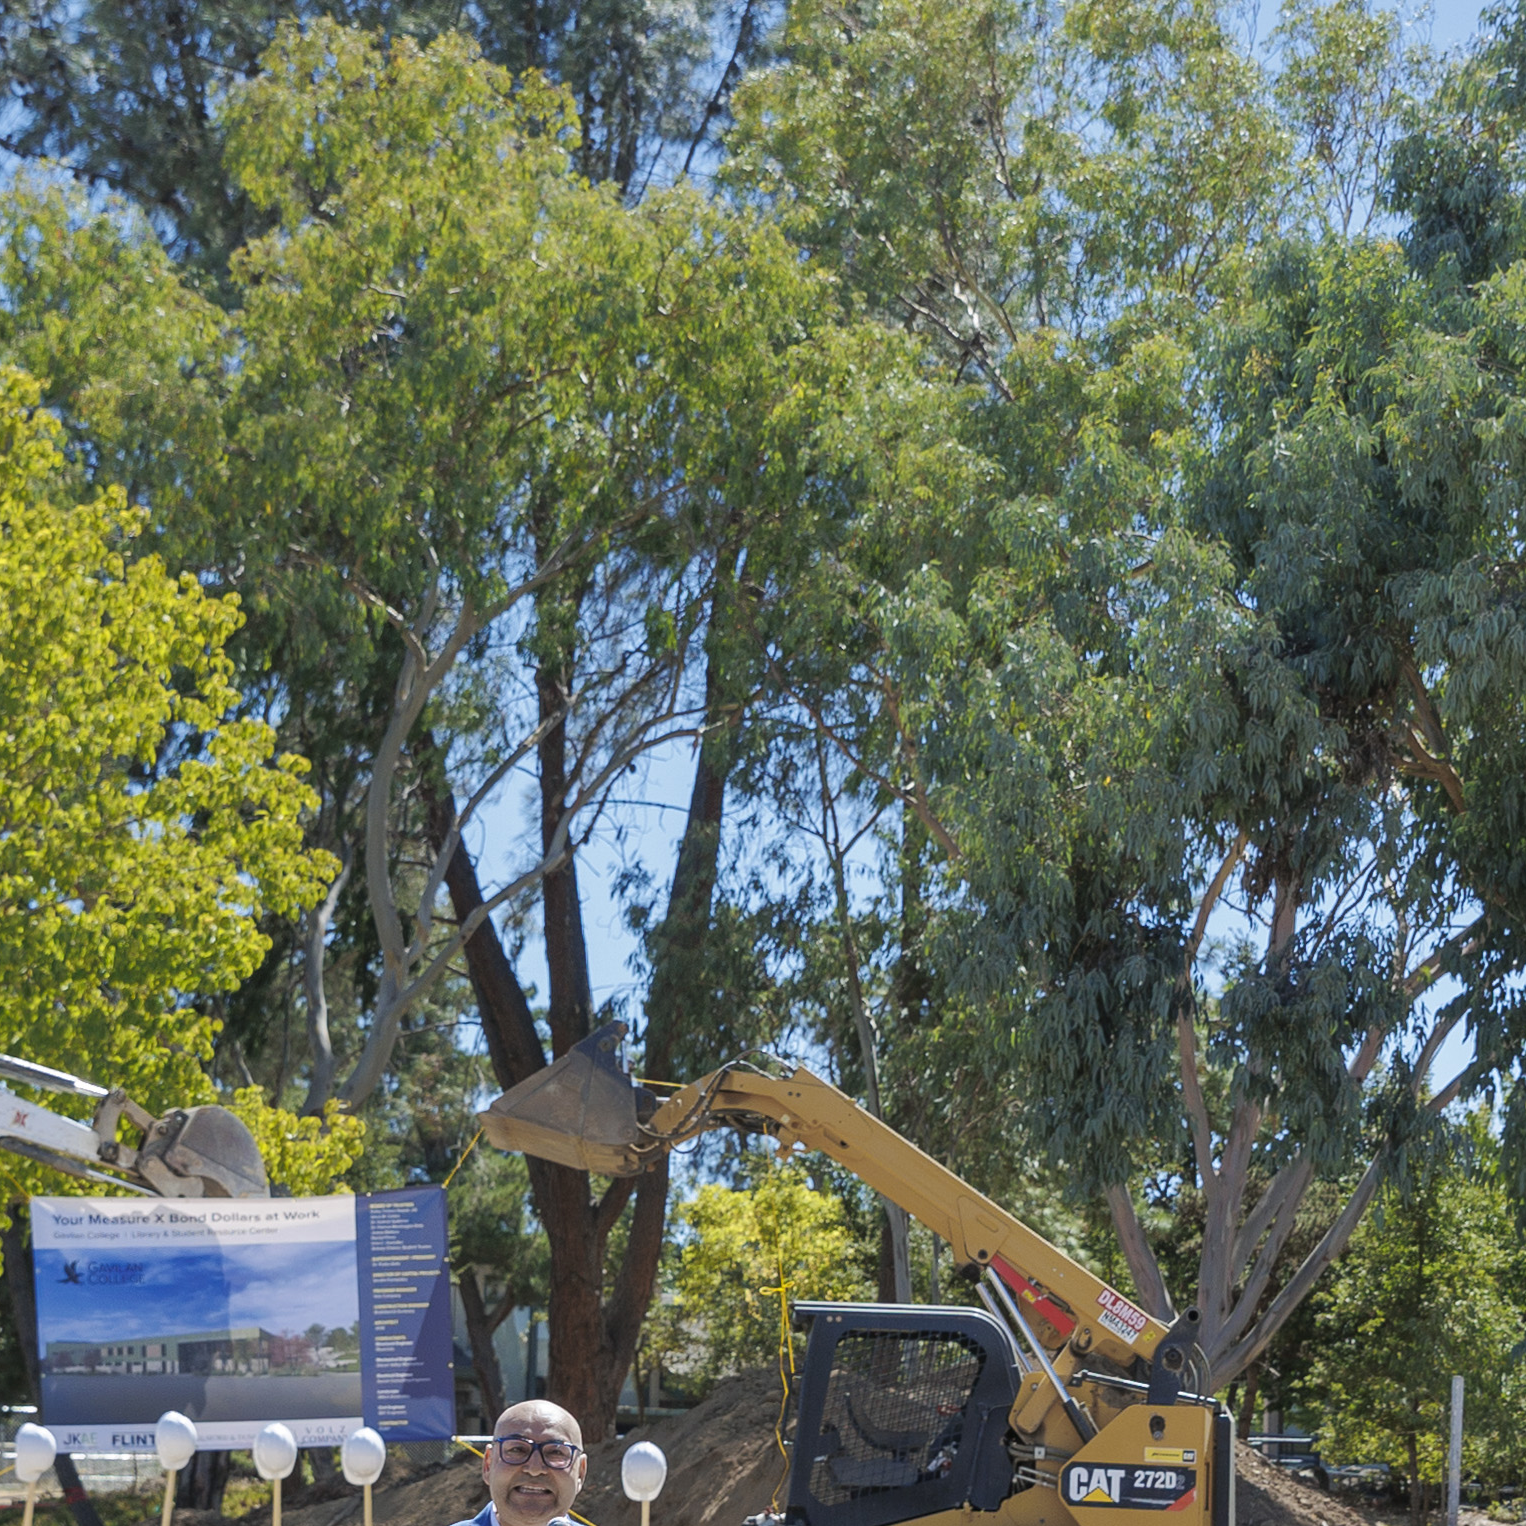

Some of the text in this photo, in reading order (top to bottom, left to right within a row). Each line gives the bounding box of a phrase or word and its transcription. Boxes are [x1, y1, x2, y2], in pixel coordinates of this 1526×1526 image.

[53, 1209, 320, 1225] Your Measure X Bond Dollars at Work
[1097, 1289, 1147, 1331] DL8M59
[1069, 1467, 1126, 1503] CAT
